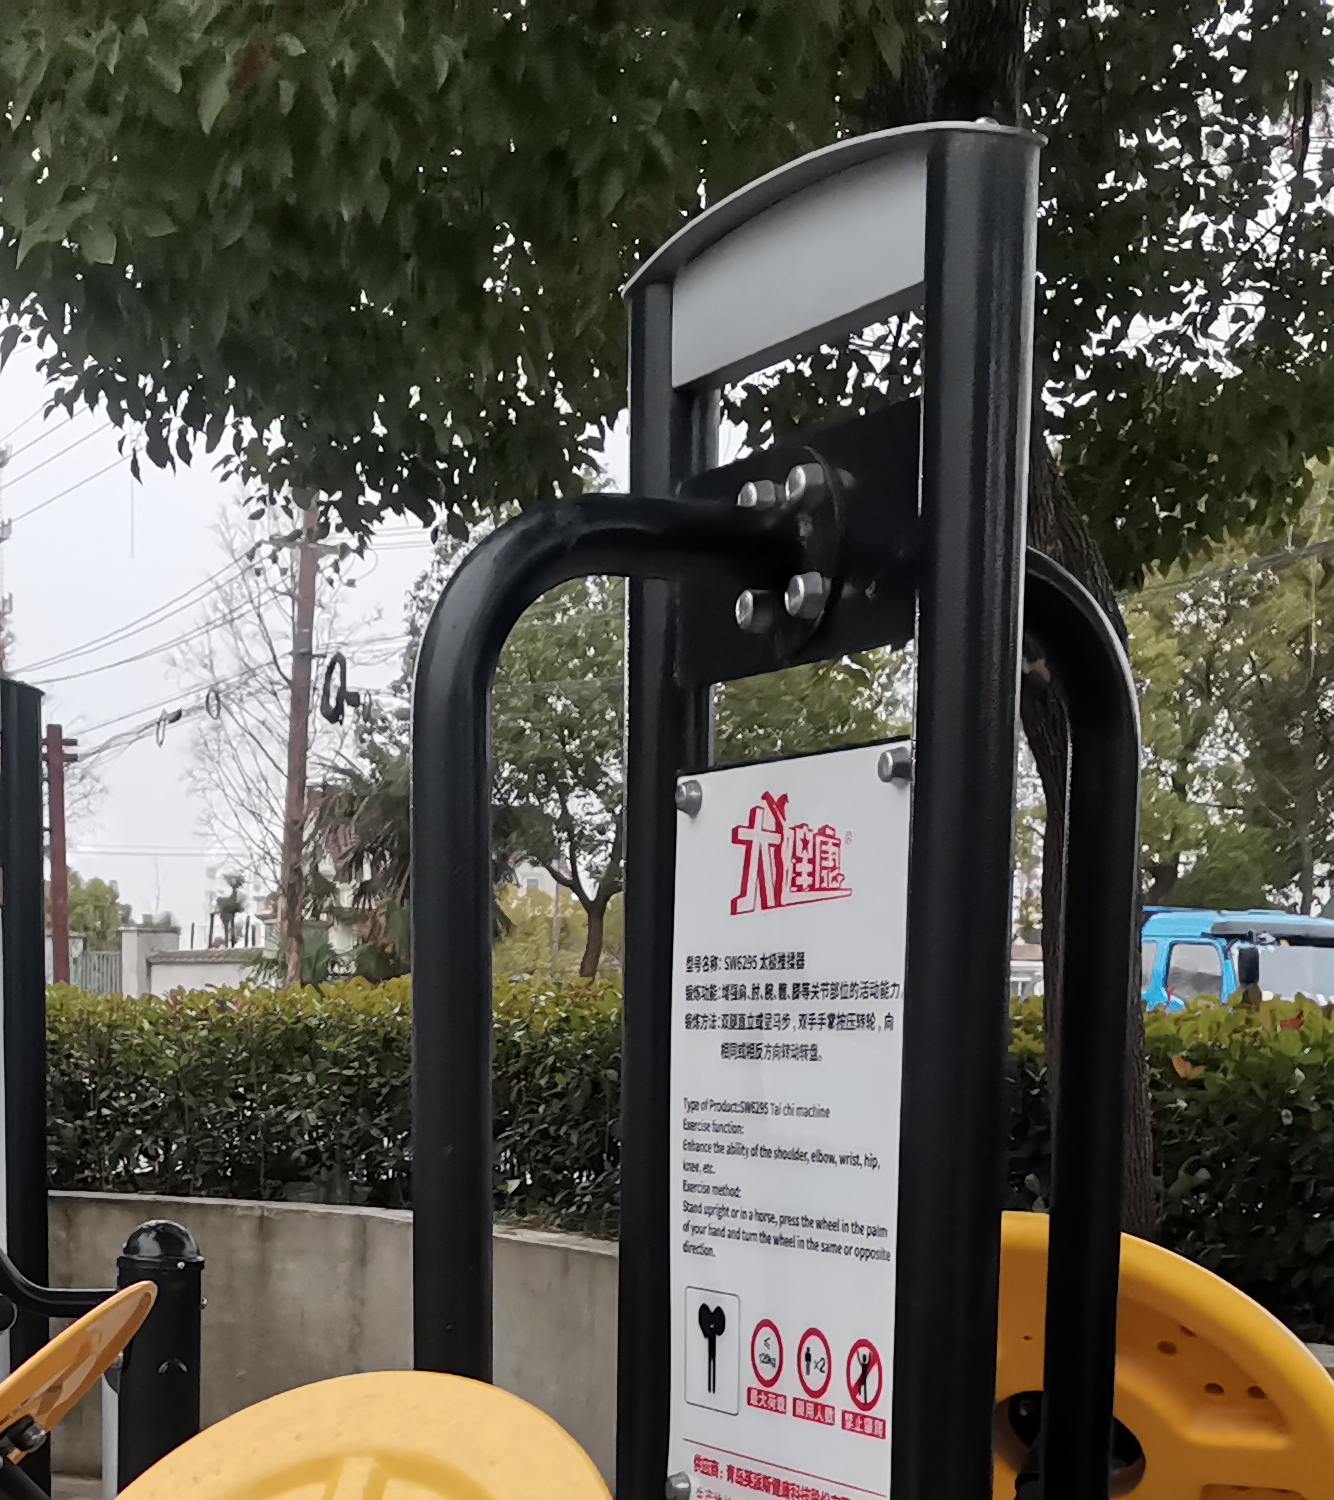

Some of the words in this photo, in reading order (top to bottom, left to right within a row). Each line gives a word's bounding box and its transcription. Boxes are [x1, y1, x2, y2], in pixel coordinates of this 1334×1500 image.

[683, 1097, 699, 1112] Type
[699, 1098, 708, 1111] of
[769, 1102, 781, 1115] Tai
[782, 1102, 794, 1116] chi
[795, 1104, 830, 1118] machine
[682, 1117, 710, 1132] Exercise
[682, 1138, 712, 1153] Enhance
[712, 1141, 725, 1154] the
[726, 1141, 749, 1159] ability
[750, 1143, 758, 1157] of
[759, 1144, 772, 1158] the
[773, 1146, 809, 1164] shoulder,
[810, 1149, 837, 1165] elbow,
[838, 1154, 862, 1168] wrist,
[863, 1153, 880, 1170] hip,
[682, 1179, 710, 1194] Exercise
[682, 1199, 702, 1214] Stand
[703, 1203, 729, 1220] upright
[730, 1208, 739, 1218] or
[738, 1209, 747, 1219] in
[748, 1210, 753, 1221] a
[754, 1209, 777, 1225] horse,
[778, 1214, 799, 1228] press
[800, 1214, 814, 1228] the
[815, 1217, 839, 1231] wheel
[841, 1219, 849, 1233] in
[850, 1220, 864, 1235] the
[865, 1225, 887, 1238] palm
[682, 1219, 690, 1232] of
[690, 1224, 707, 1236] your
[707, 1223, 725, 1238] hand
[726, 1227, 740, 1240] and
[741, 1229, 757, 1241] turn
[758, 1230, 771, 1244] the
[772, 1233, 795, 1247] wheel
[796, 1234, 804, 1249] in
[805, 1236, 819, 1251] the
[820, 1241, 842, 1254] same
[843, 1244, 853, 1256] or
[853, 1246, 890, 1261] opposite
